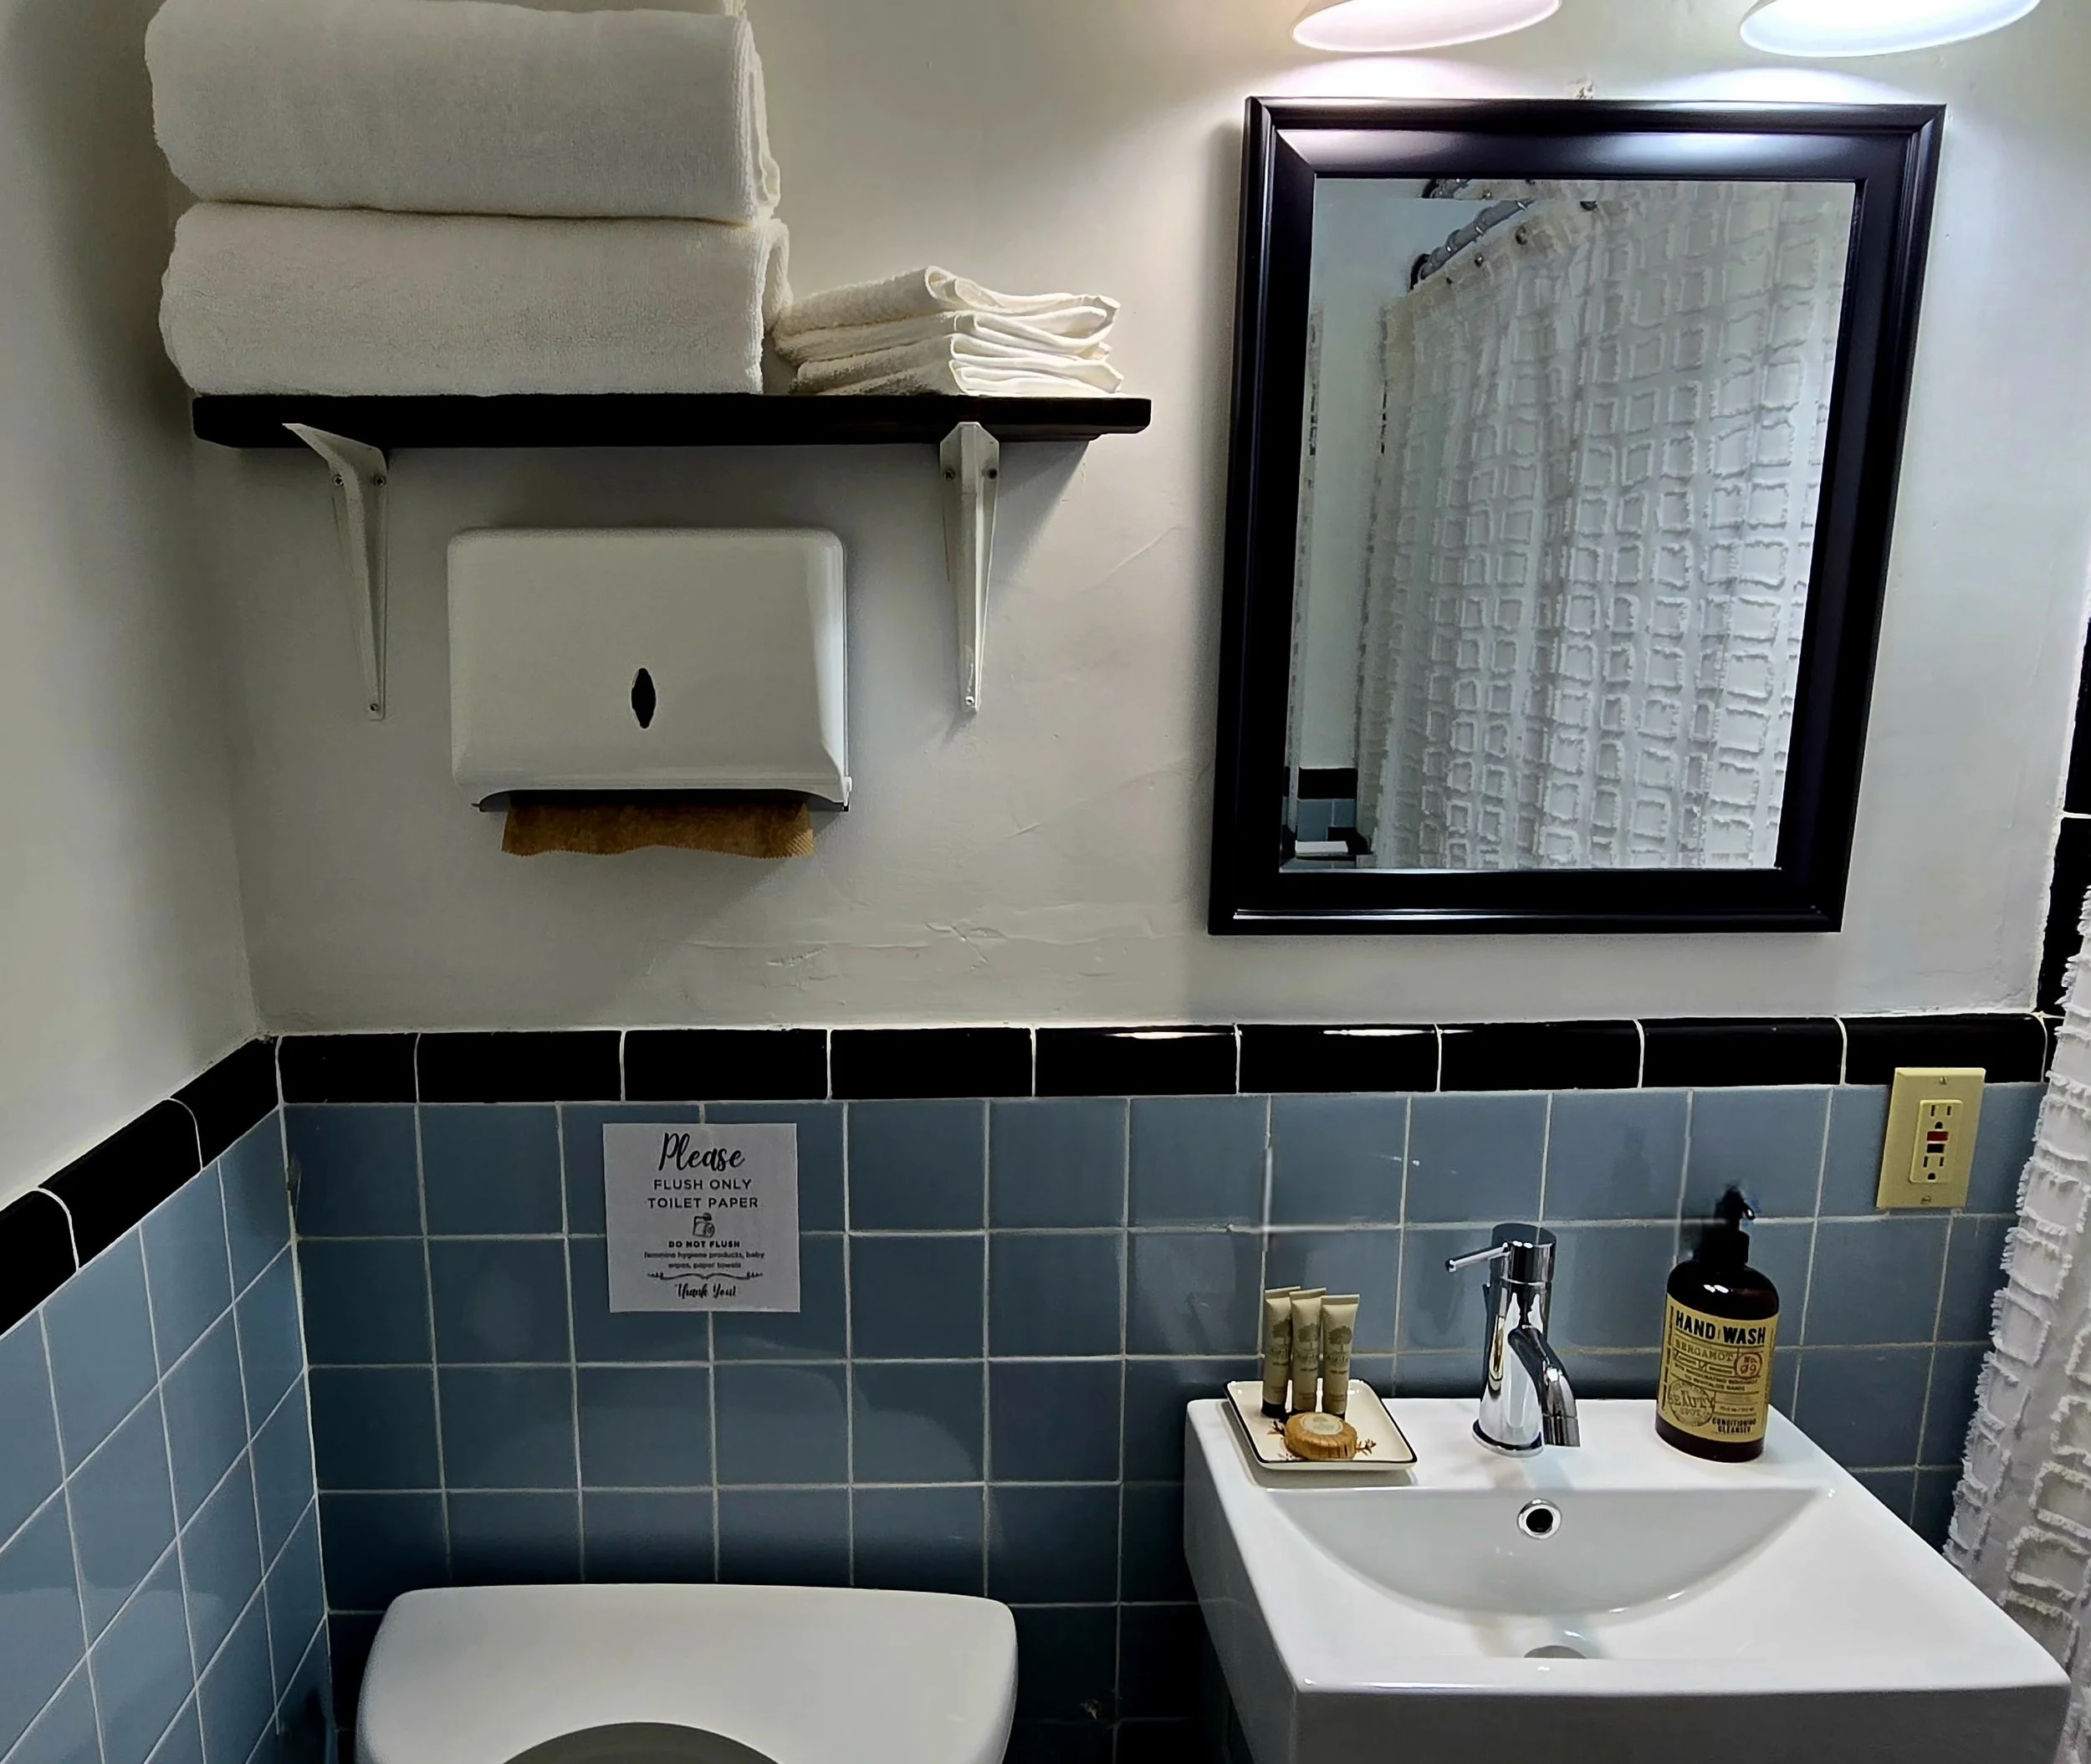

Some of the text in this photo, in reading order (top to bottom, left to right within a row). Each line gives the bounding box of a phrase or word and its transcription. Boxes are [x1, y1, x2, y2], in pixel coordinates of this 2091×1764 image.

[658, 1132, 745, 1172] Please
[653, 1179, 753, 1190] FLUSH ONLY
[647, 1197, 759, 1209] TOILET PAPER
[668, 1240, 741, 1249] DO NOT FLUSH
[643, 1251, 765, 1260] feminine hygiene products, baby
[667, 1262, 693, 1271] wipes,
[693, 1262, 715, 1271] paper
[674, 1283, 737, 1300] Thank You!
[1675, 1309, 1766, 1345] HAND WASH
[1674, 1339, 1735, 1363] BERGAMOT
[1668, 1389, 1715, 1409] BEAUTY
[1711, 1417, 1757, 1427] CONDITIONING
[1717, 1425, 1751, 1434] CLEANSER
